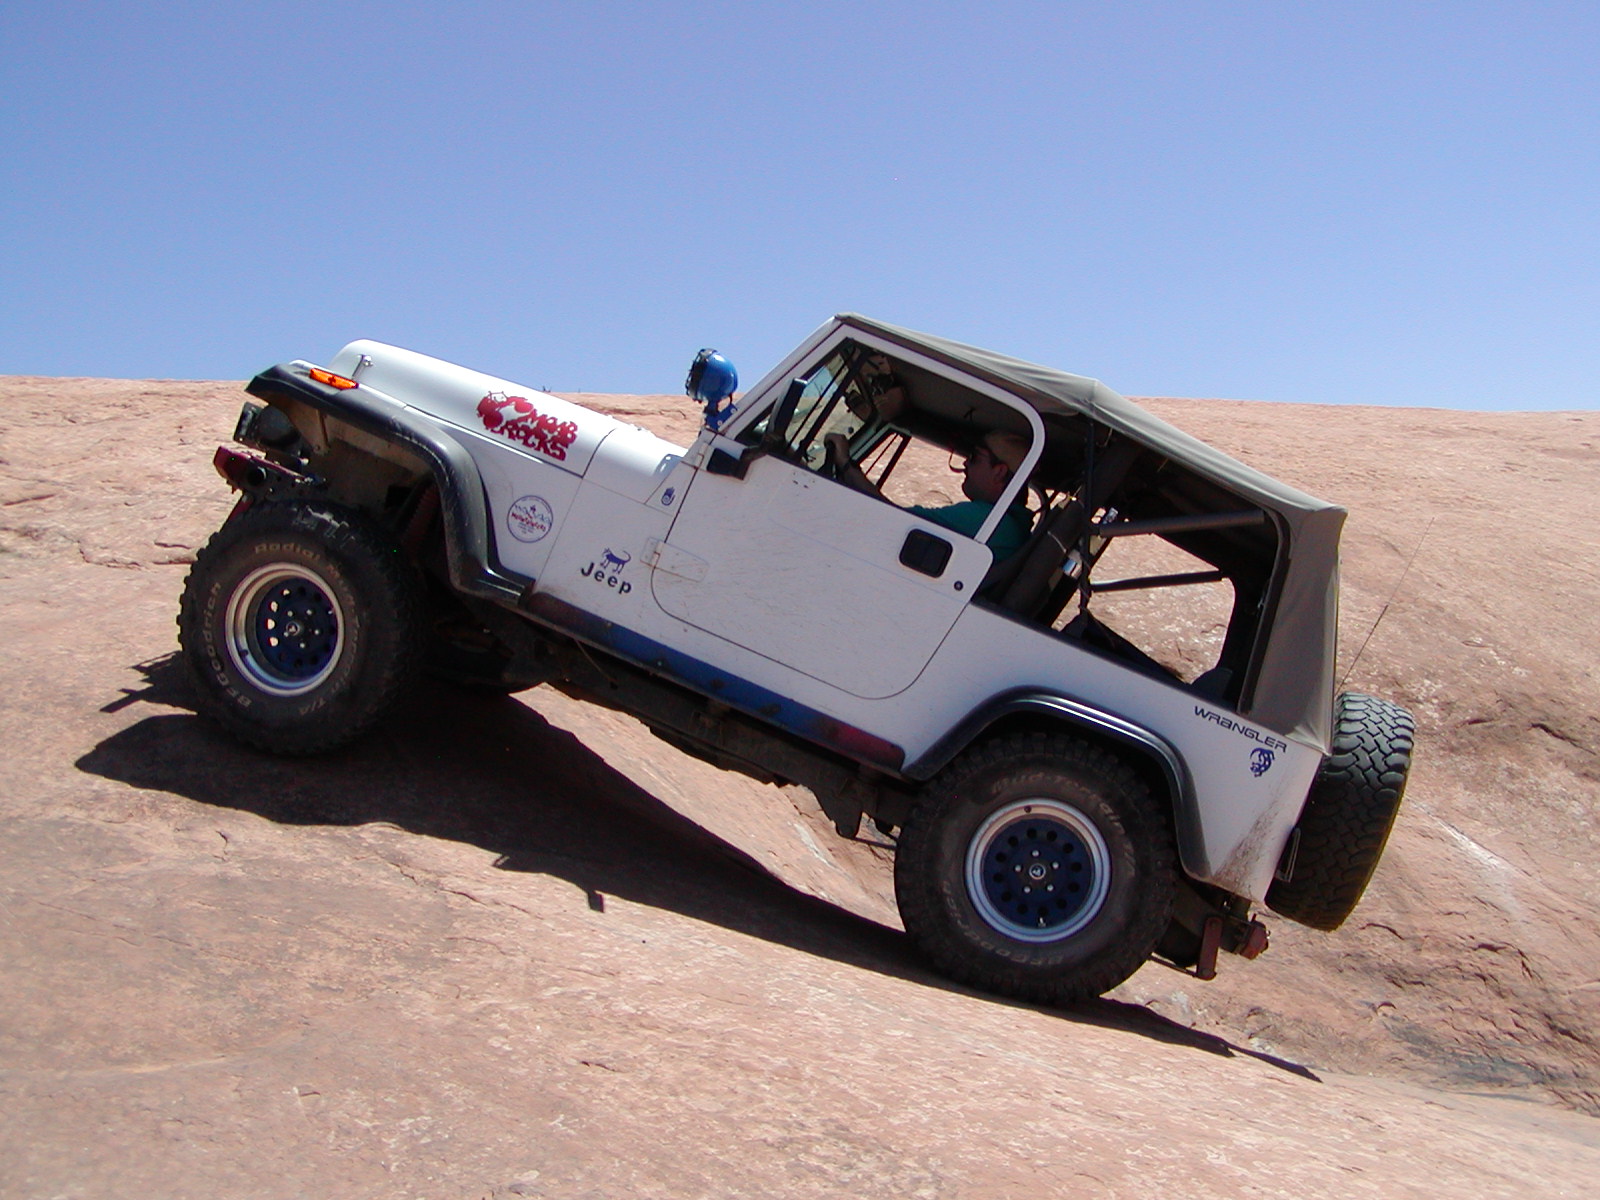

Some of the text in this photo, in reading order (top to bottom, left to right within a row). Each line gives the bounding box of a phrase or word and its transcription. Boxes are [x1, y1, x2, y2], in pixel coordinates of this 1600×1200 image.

[490, 420, 568, 461] ROCKS
[254, 541, 321, 562] Radial
[579, 561, 633, 595] Jeep
